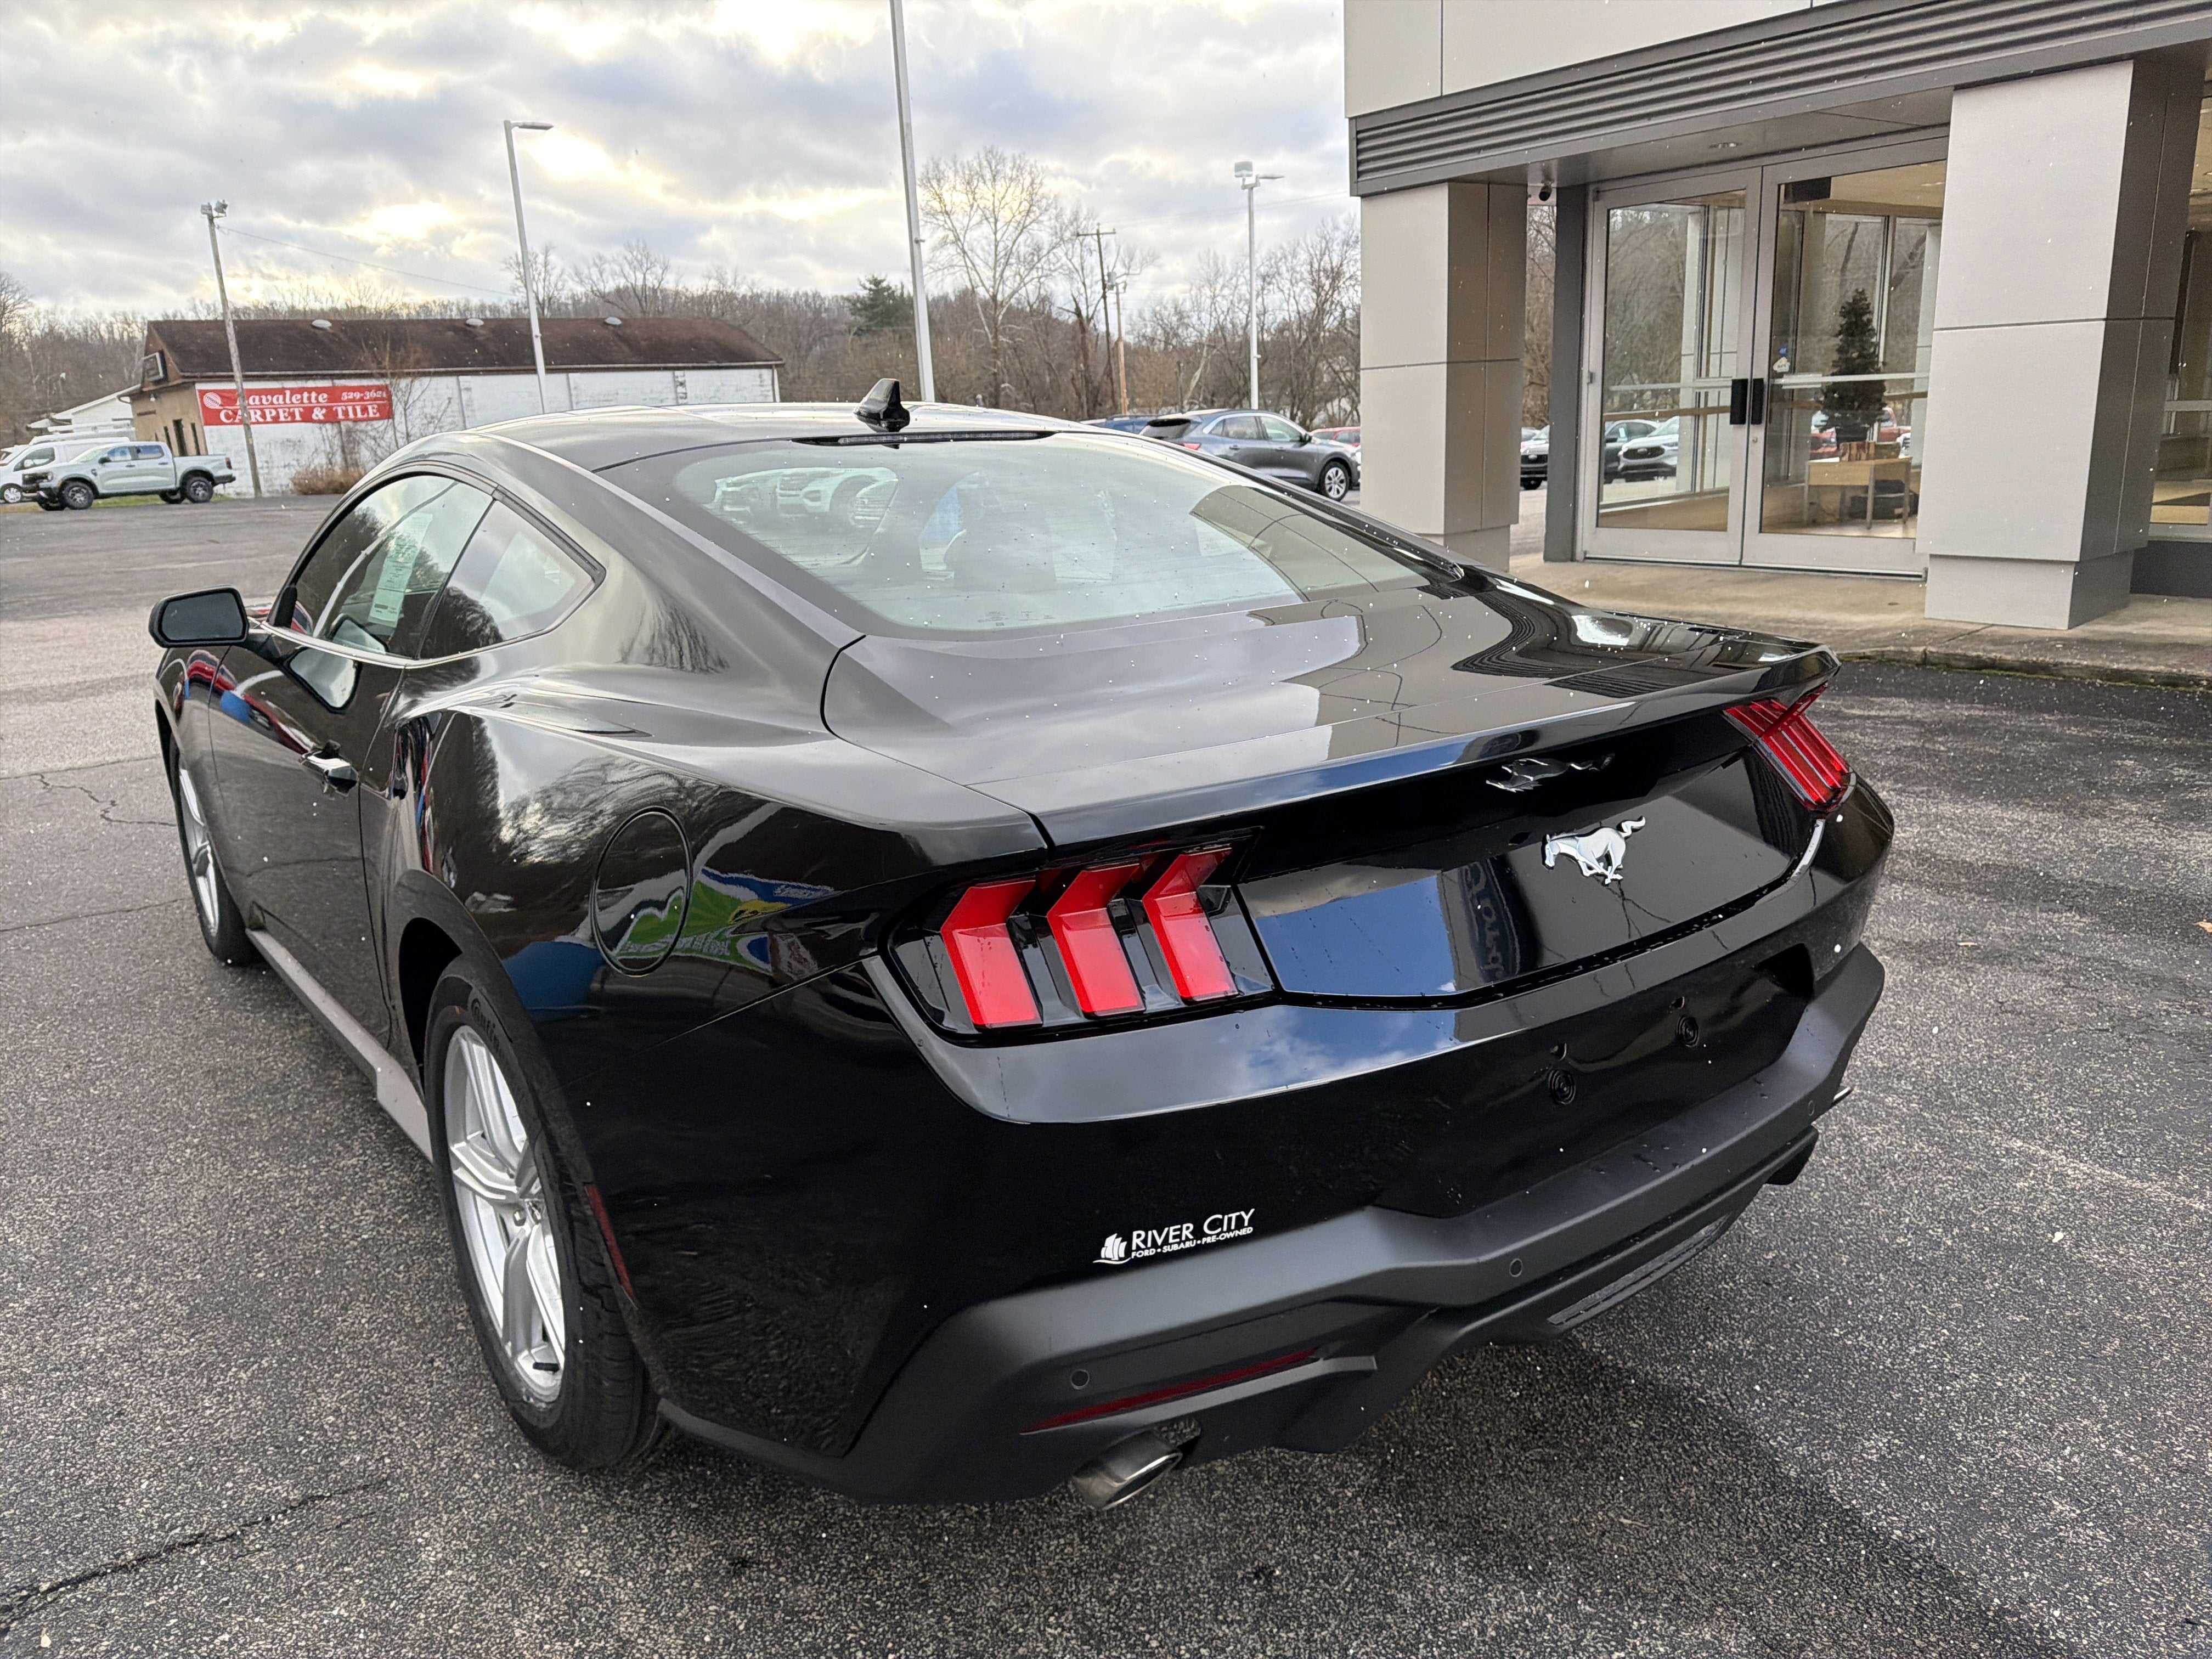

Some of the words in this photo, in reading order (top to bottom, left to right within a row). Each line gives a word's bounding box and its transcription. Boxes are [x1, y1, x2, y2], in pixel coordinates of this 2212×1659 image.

[219, 408, 303, 423] CARPET
[311, 407, 326, 420] &
[333, 404, 380, 419] TILE
[1131, 1248, 1156, 1259] FORD
[1162, 1240, 1196, 1253] SUBARU
[1201, 1227, 1253, 1244] PRE-OWNED
[1132, 1223, 1194, 1250] RIVER
[1203, 1208, 1255, 1234] CITY
